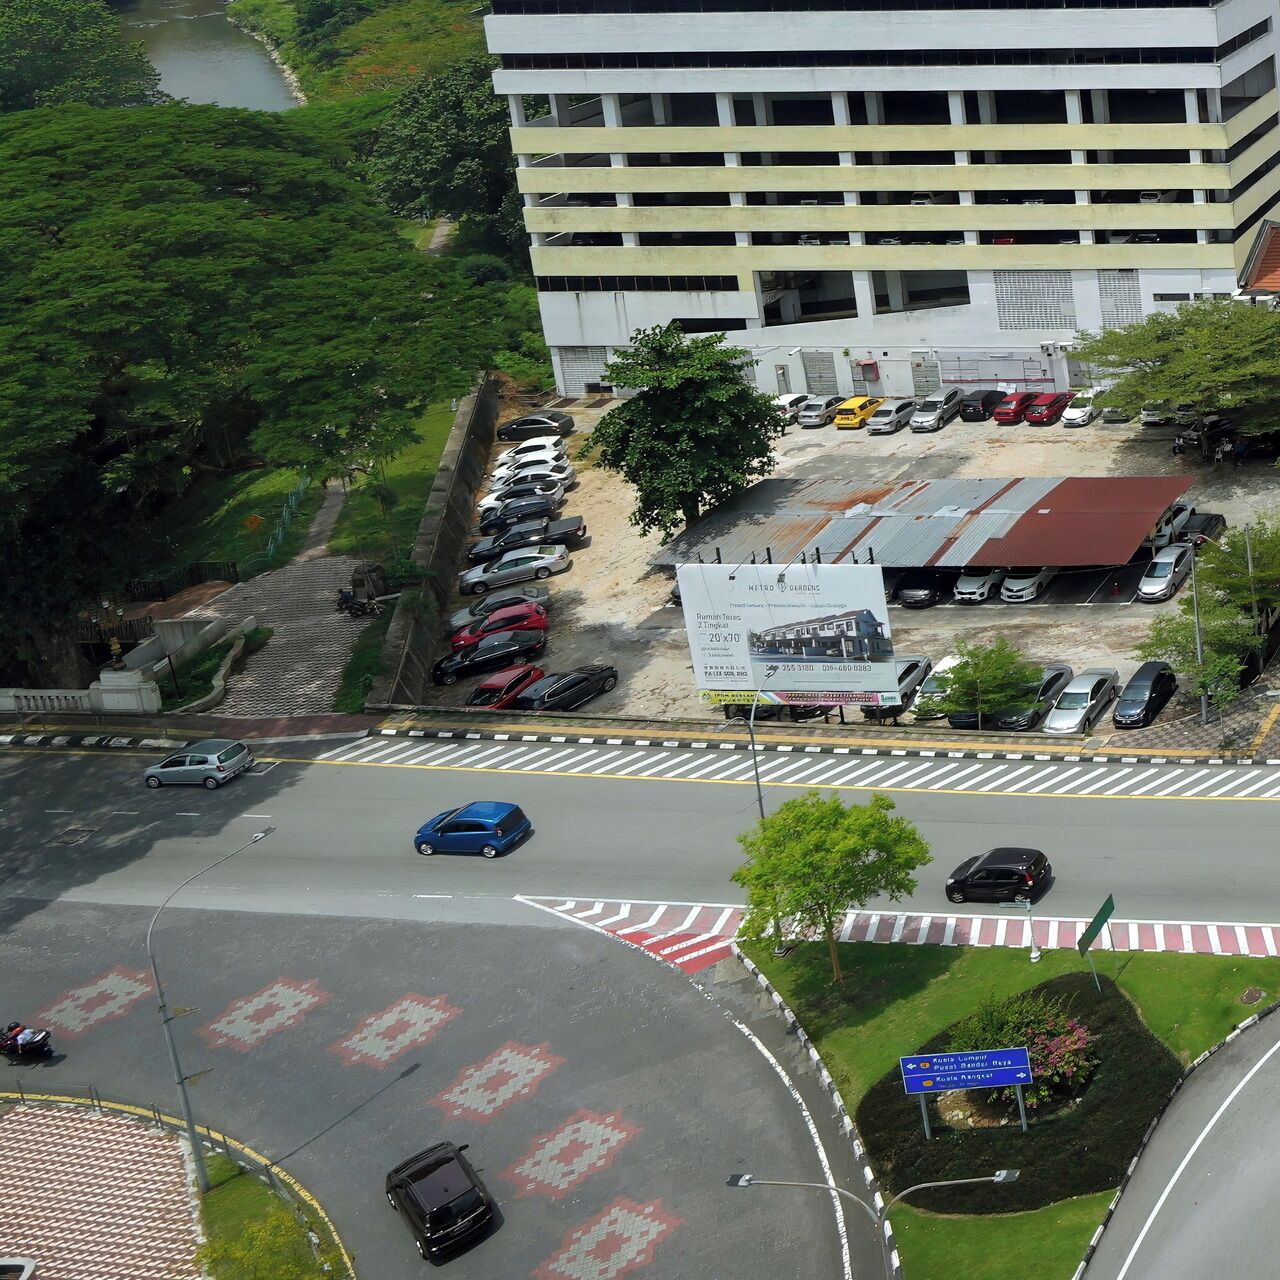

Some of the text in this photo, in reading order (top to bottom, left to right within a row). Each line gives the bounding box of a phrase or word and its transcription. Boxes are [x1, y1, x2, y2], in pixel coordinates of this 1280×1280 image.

[748, 584, 821, 592] METRO GARDENS
[696, 613, 722, 621] Rumah
[704, 622, 729, 630] Tingkat
